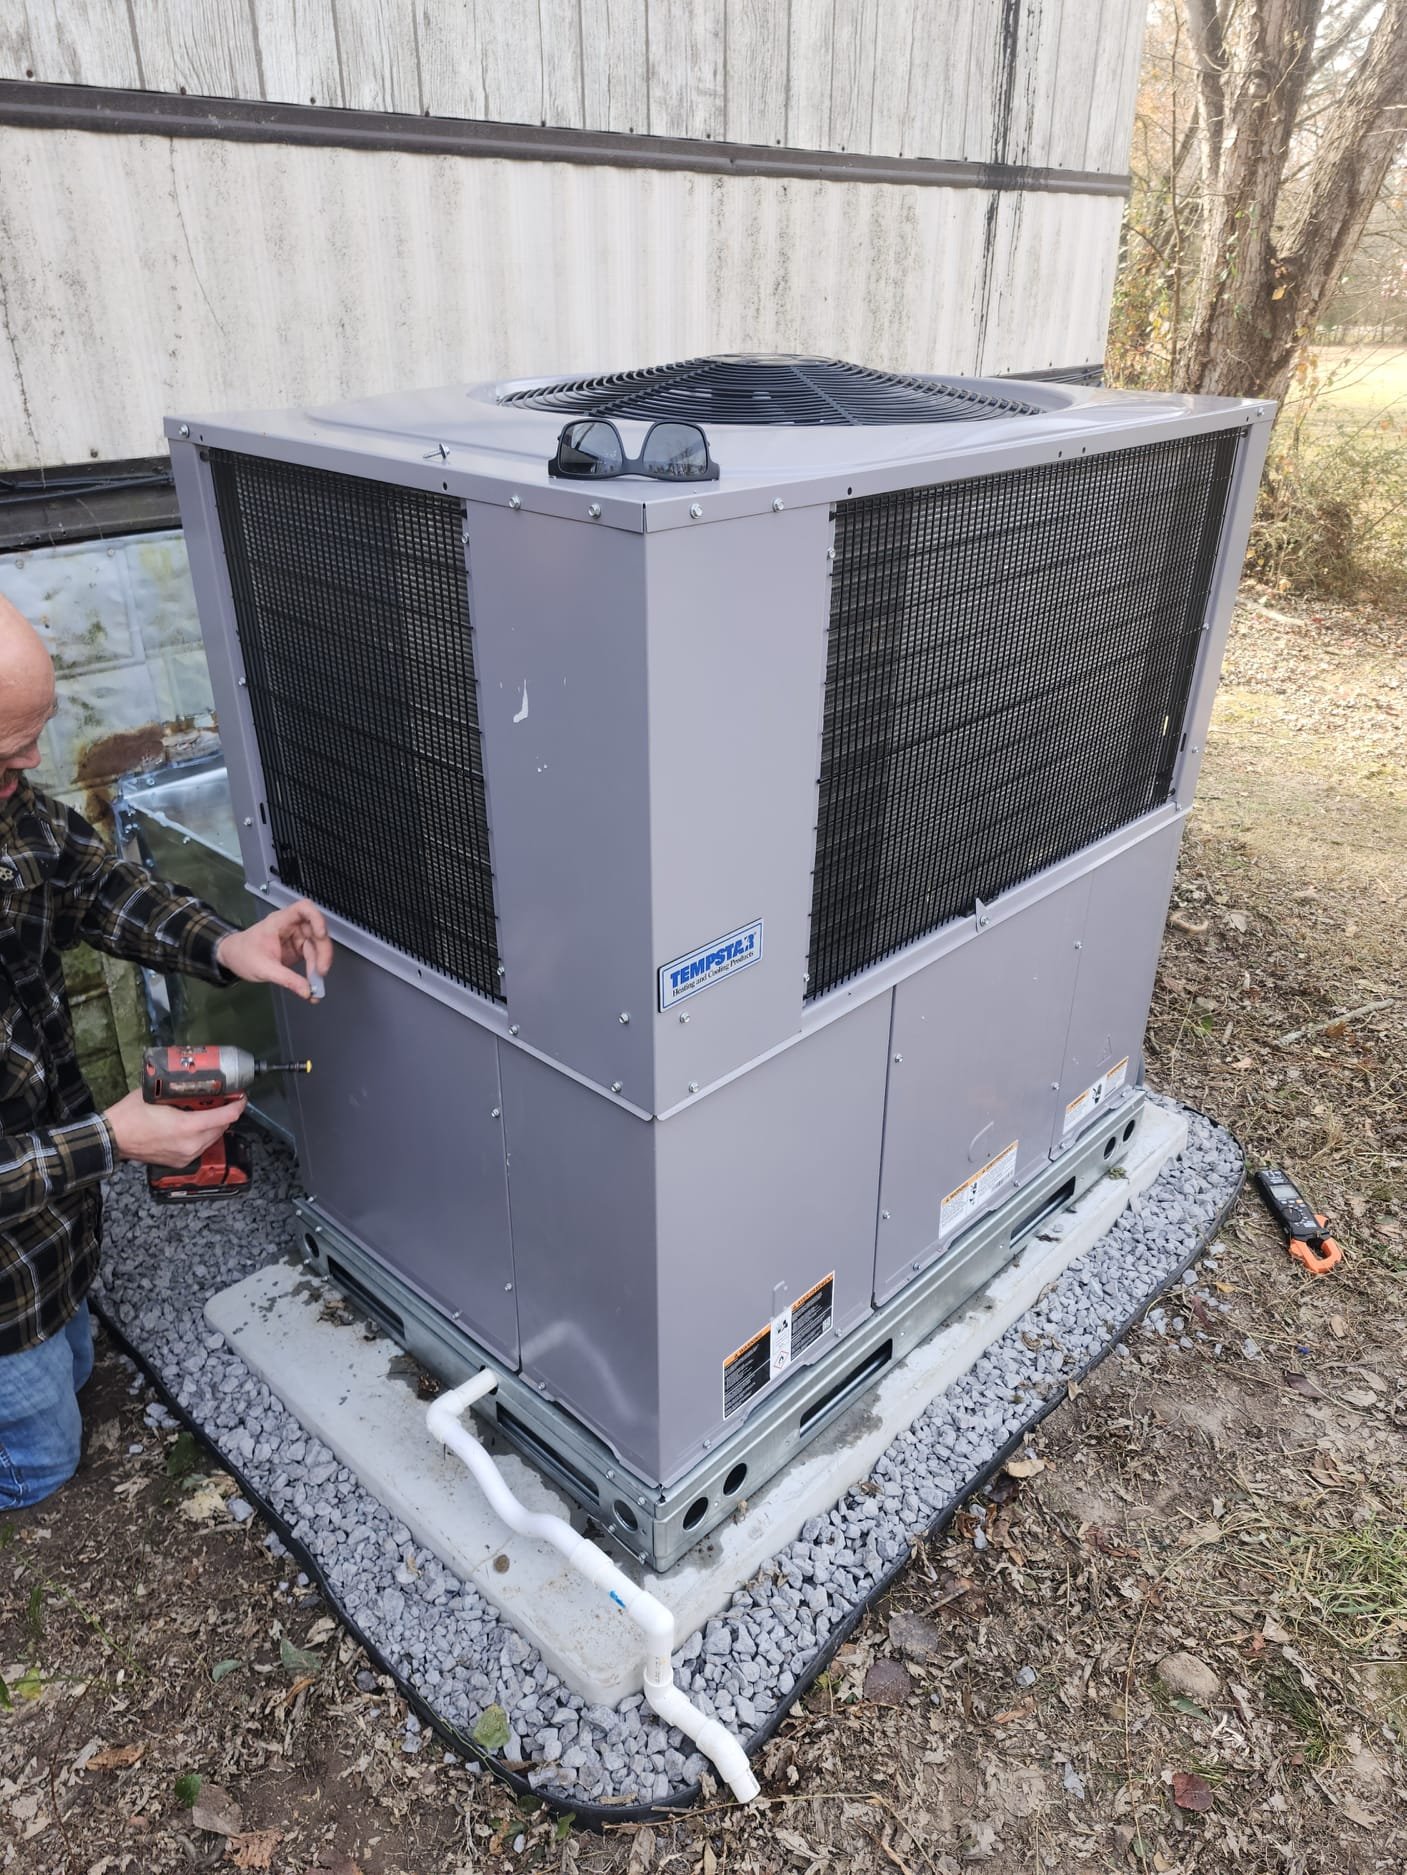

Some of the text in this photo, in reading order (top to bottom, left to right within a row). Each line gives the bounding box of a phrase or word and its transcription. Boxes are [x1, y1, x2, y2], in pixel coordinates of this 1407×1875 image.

[672, 951, 754, 997] Heating and Cooling Products
